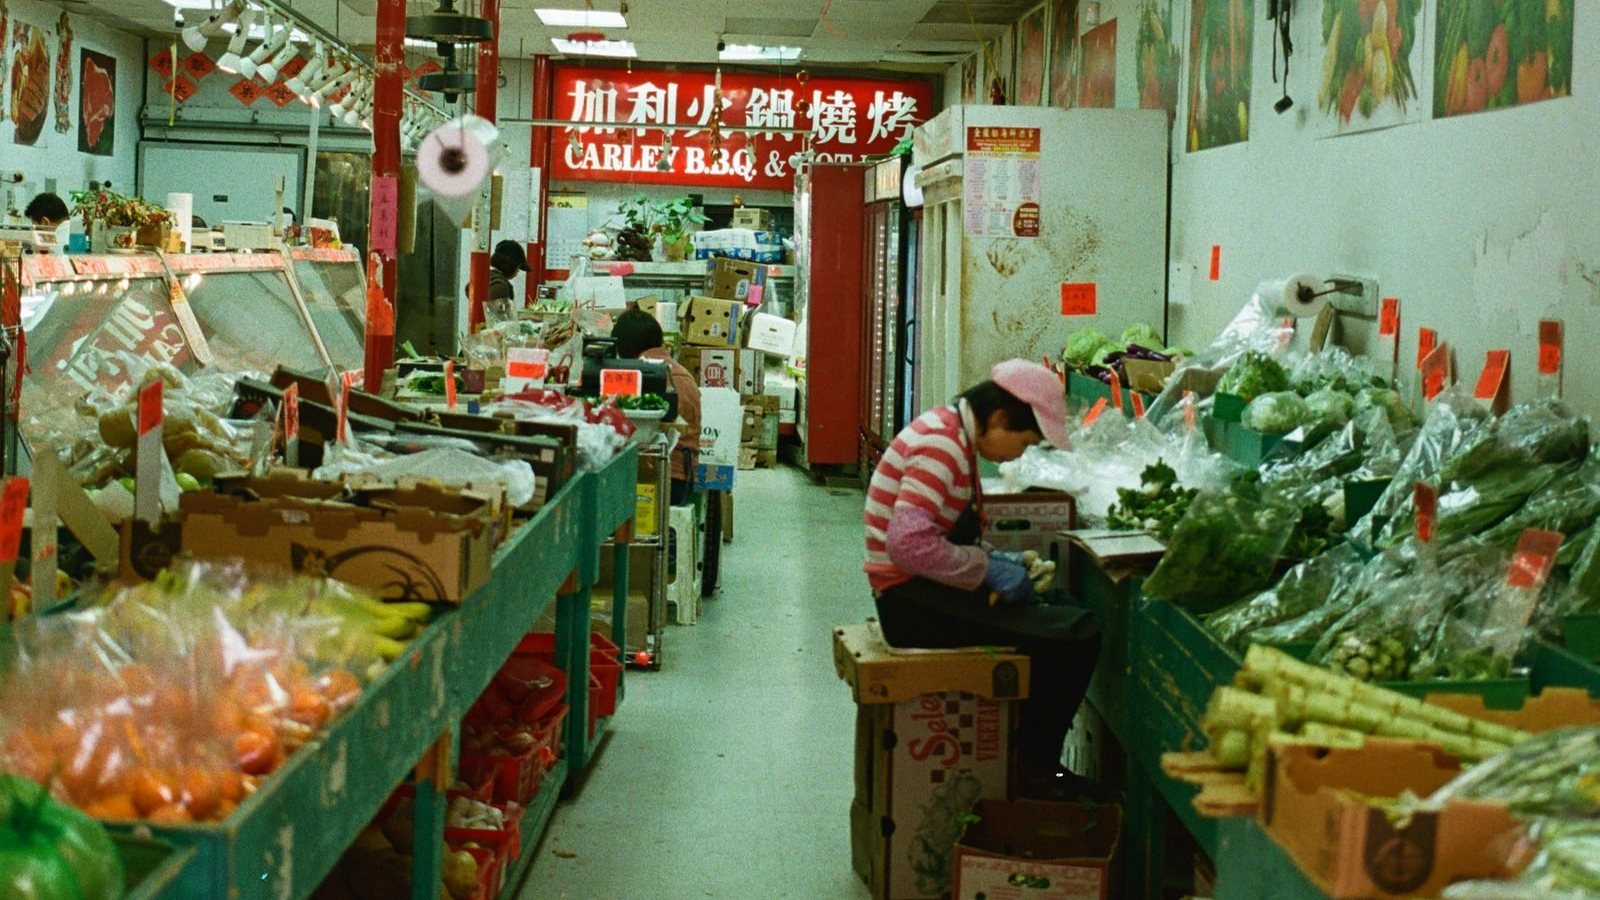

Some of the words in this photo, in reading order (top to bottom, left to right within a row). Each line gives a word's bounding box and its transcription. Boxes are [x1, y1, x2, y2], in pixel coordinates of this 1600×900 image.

[565, 80, 922, 144] 加利火鍋燒烤
[764, 150, 786, 177] &
[908, 692, 960, 766] Sele
